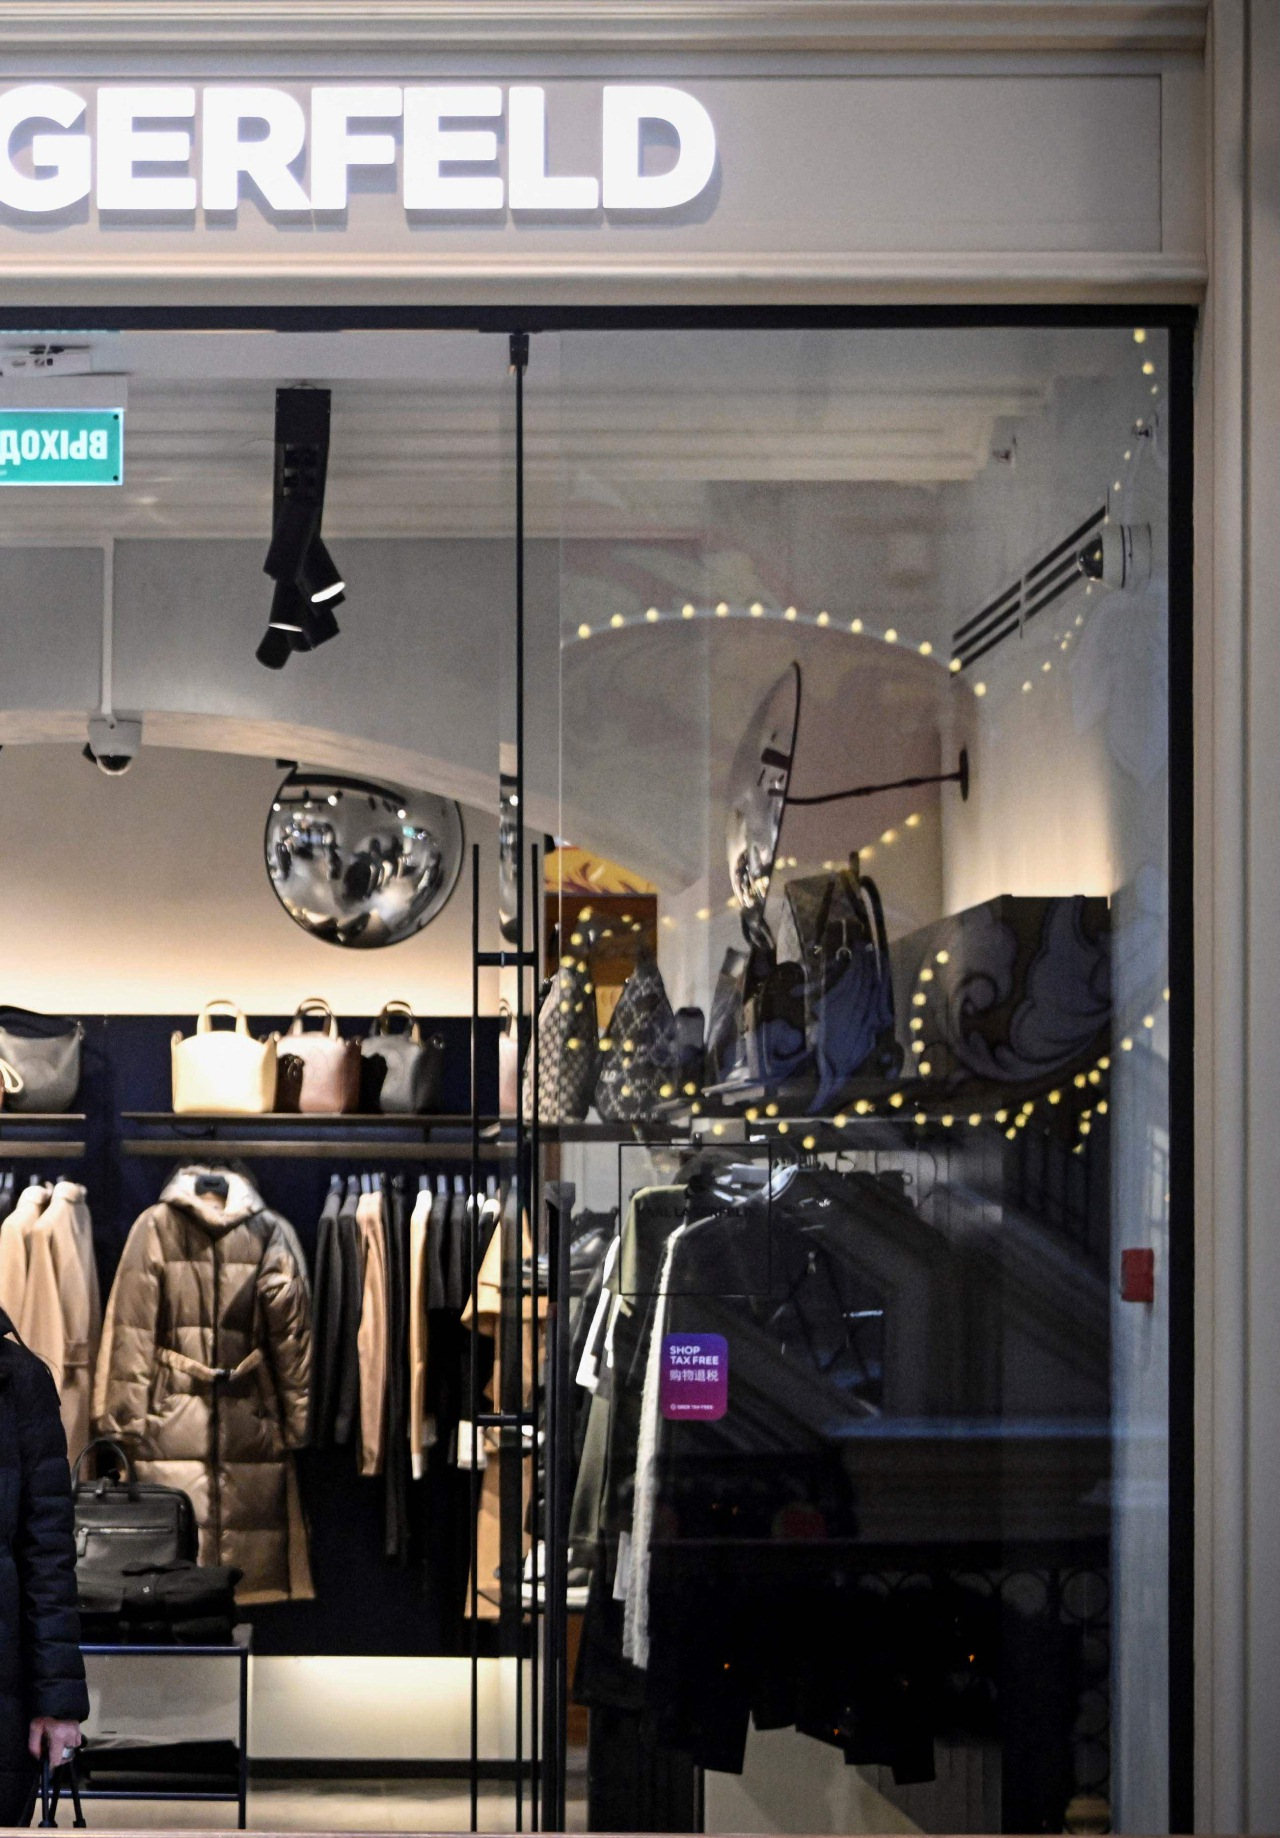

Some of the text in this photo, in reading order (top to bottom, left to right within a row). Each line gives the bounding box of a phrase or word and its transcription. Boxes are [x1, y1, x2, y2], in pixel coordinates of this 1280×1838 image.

[669, 1345, 700, 1355] SHOP
[669, 1356, 719, 1365] TAX FREE
